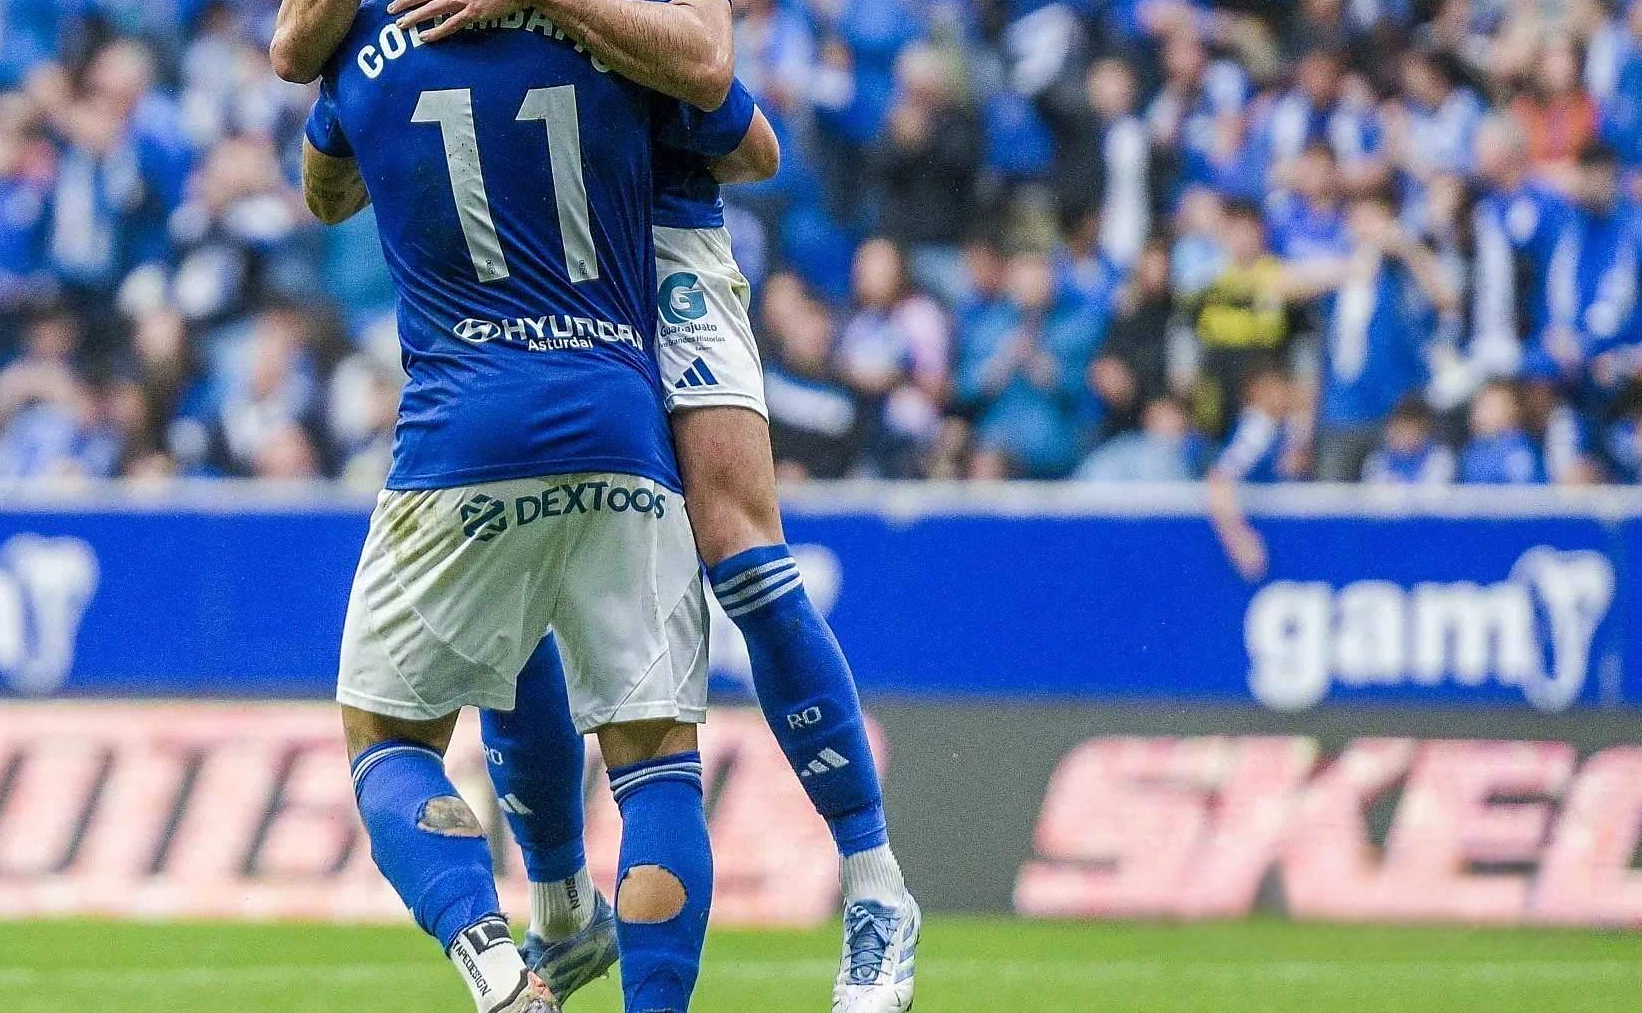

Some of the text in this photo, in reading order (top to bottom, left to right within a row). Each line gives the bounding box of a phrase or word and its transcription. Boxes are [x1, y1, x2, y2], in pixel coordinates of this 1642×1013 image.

[409, 84, 600, 284] 11
[501, 314, 644, 351] HYUNDAI
[527, 336, 594, 352] Asturdai
[452, 938, 492, 997] TAPEDESIGN
